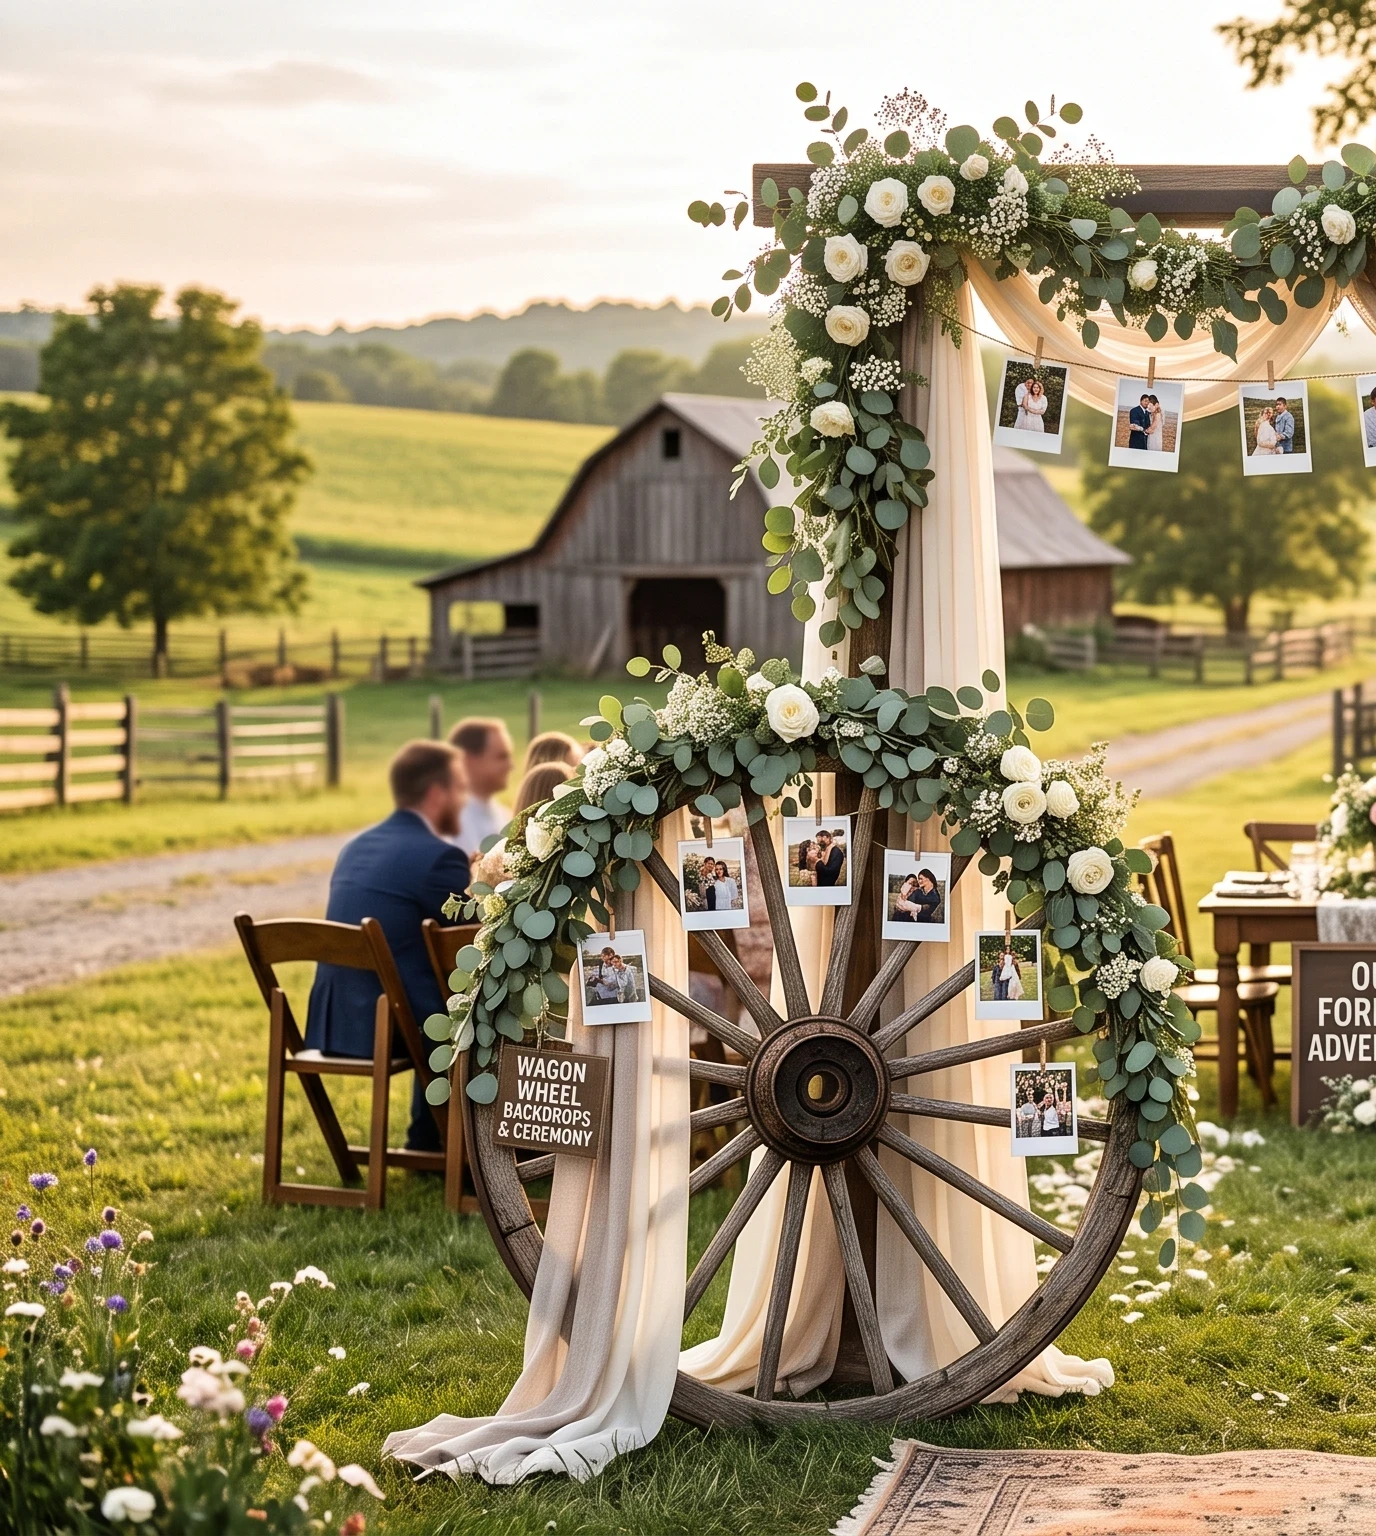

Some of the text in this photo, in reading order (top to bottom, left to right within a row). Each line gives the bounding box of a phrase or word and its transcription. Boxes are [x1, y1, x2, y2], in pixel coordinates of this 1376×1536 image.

[517, 1055, 587, 1083] WAGON
[517, 1079, 582, 1107] WHEEL
[503, 1101, 591, 1128] BACKDROPS
[497, 1120, 593, 1147] & CEREMONY
